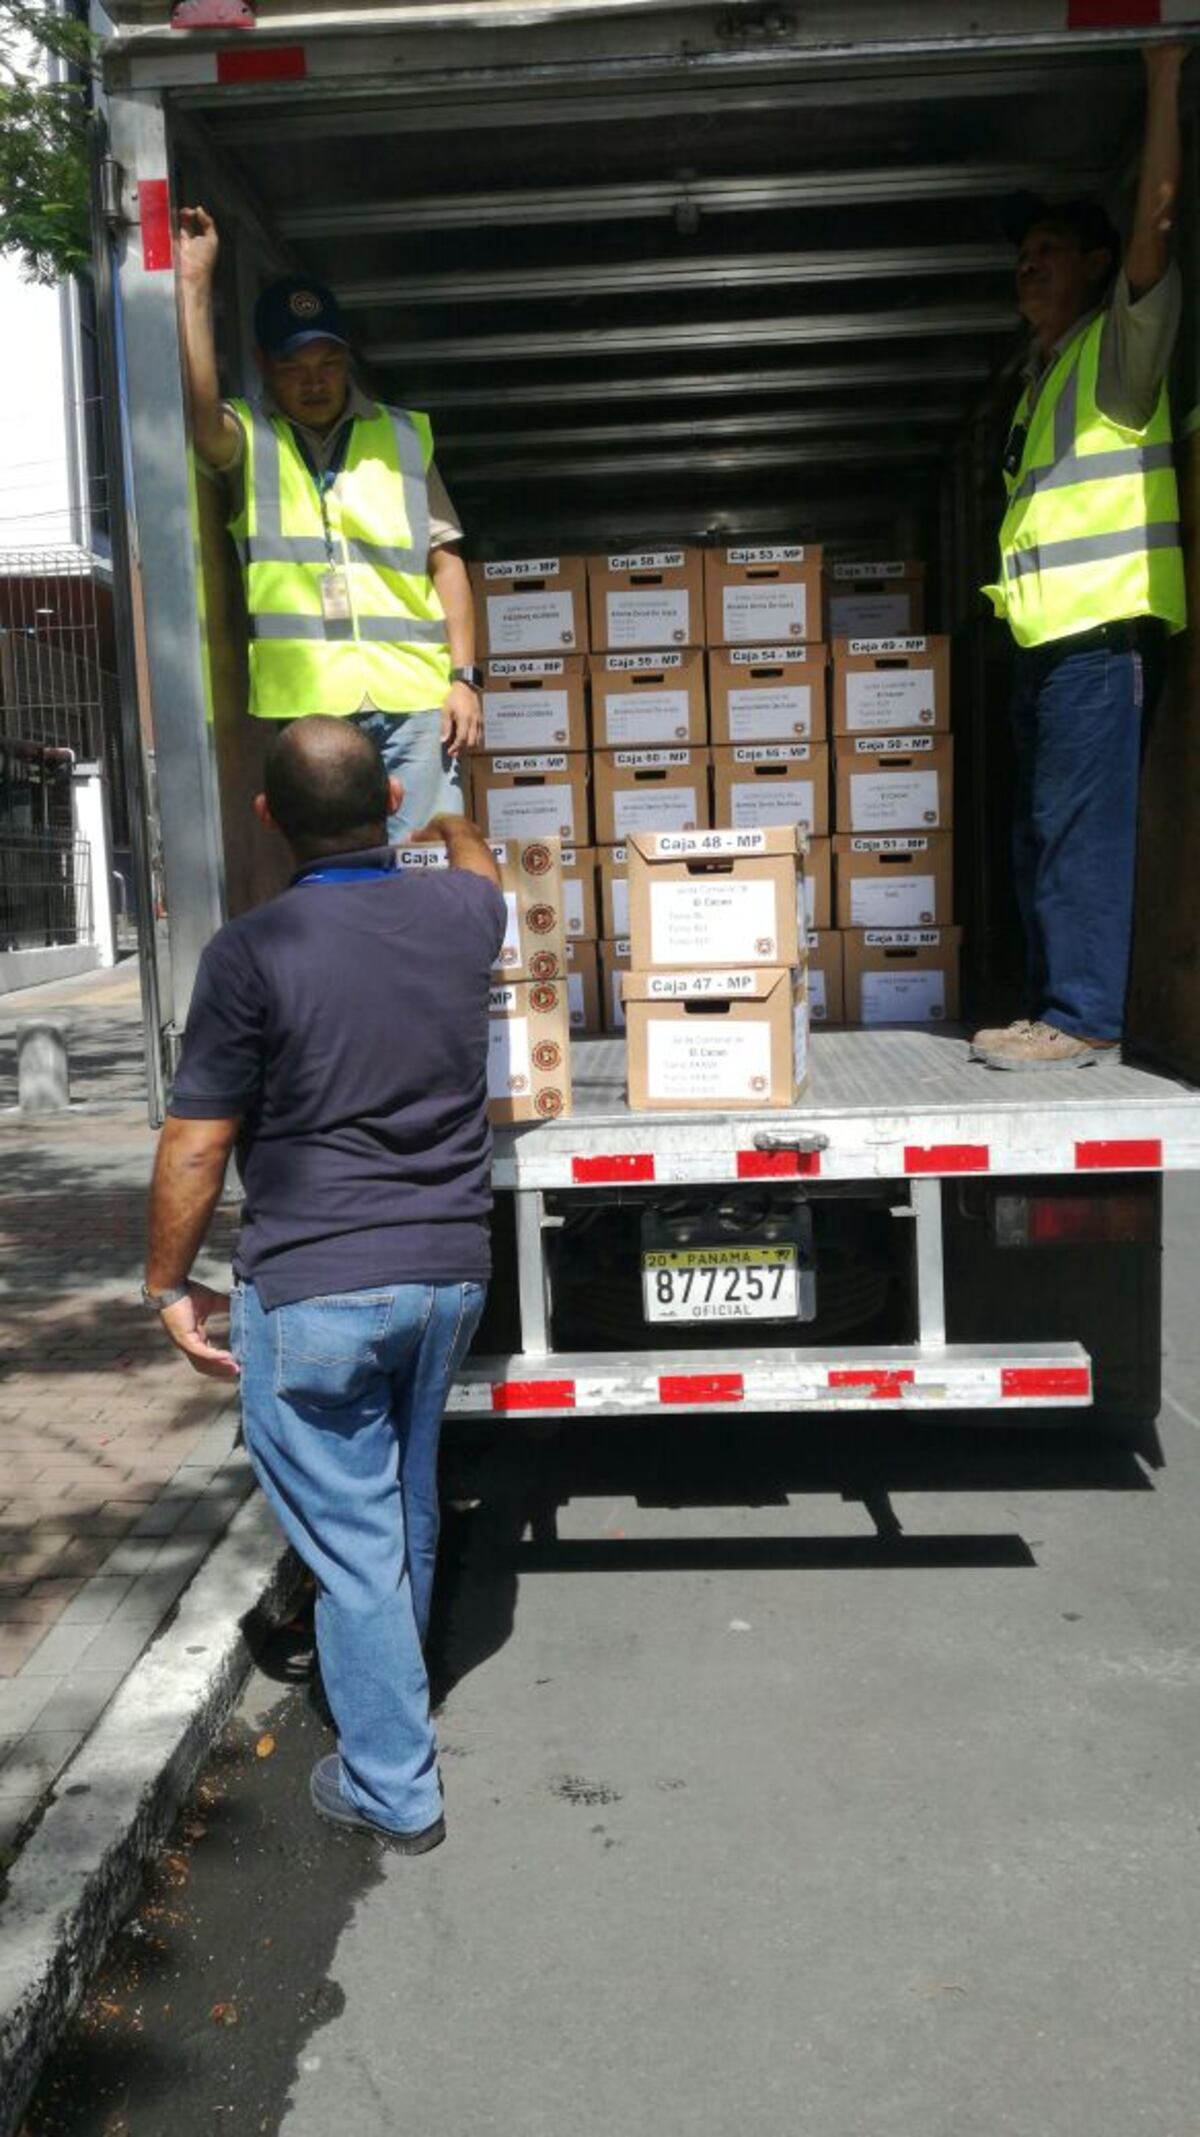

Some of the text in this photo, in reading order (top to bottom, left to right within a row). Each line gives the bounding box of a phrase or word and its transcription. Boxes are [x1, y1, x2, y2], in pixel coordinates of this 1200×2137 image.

[730, 550, 755, 561] Caja
[759, 550, 773, 560] 53
[783, 549, 801, 558] MP
[611, 558, 637, 569] Caja
[664, 554, 681, 564] MP
[486, 566, 512, 576] Caja
[539, 562, 557, 571] MP
[852, 642, 878, 653] Caja
[905, 640, 924, 649] MP
[609, 658, 635, 668] Caja
[661, 655, 679, 665] MP
[733, 652, 758, 662] Caja
[761, 651, 776, 660] 54
[786, 650, 803, 659] MP
[491, 663, 517, 674] Caja
[544, 663, 561, 671] MP
[858, 741, 884, 751] Caja
[912, 740, 930, 748] MP
[618, 754, 643, 764] Caja
[669, 752, 687, 761] MP
[737, 750, 763, 760] Caja
[790, 748, 807, 756] MP
[495, 760, 521, 770] Caja
[547, 758, 564, 767] MP
[660, 837, 697, 851] Caja
[701, 836, 722, 848] 48
[737, 835, 762, 847] MP
[854, 840, 880, 851] Caja
[883, 840, 897, 848] 51
[908, 840, 925, 848] MP
[401, 852, 438, 866] Caja
[867, 934, 893, 944] Caja
[652, 980, 688, 994] Caja
[692, 978, 712, 990] 47
[727, 977, 752, 989] MP
[489, 992, 512, 1005] MP
[648, 1255, 667, 1267] 20
[687, 1252, 752, 1265] PANAMA
[656, 1264, 786, 1304] 877257
[692, 1305, 752, 1317] OFICIAL
